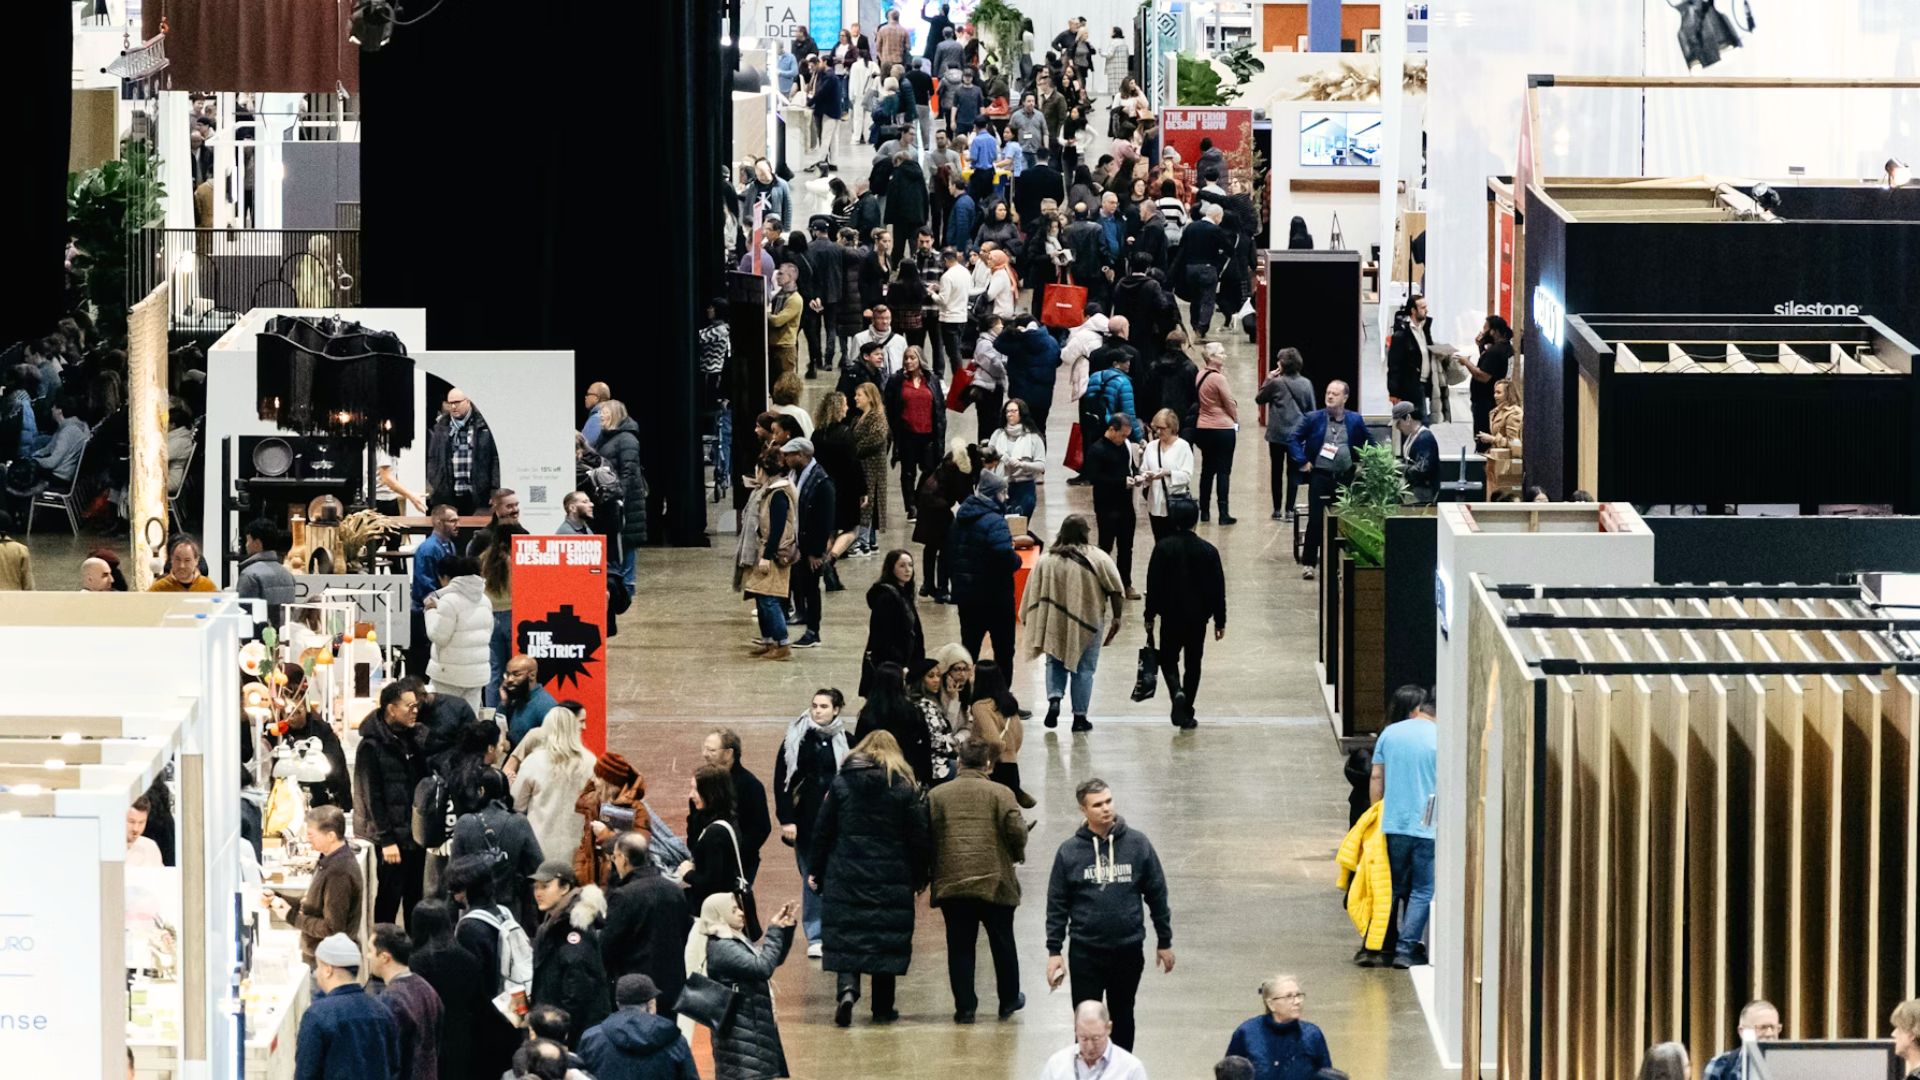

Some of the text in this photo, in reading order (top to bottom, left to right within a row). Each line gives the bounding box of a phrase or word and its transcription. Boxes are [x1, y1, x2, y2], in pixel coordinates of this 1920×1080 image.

[1165, 112, 1227, 122] THE INTERIOR
[1165, 121, 1227, 130] DESIGN SHOW
[1774, 300, 1859, 316] silestone
[516, 540, 602, 553] THE INTERIOR
[515, 552, 602, 566] DESIGN SHOW
[527, 631, 553, 645] THE
[527, 644, 586, 659] DISTRICT
